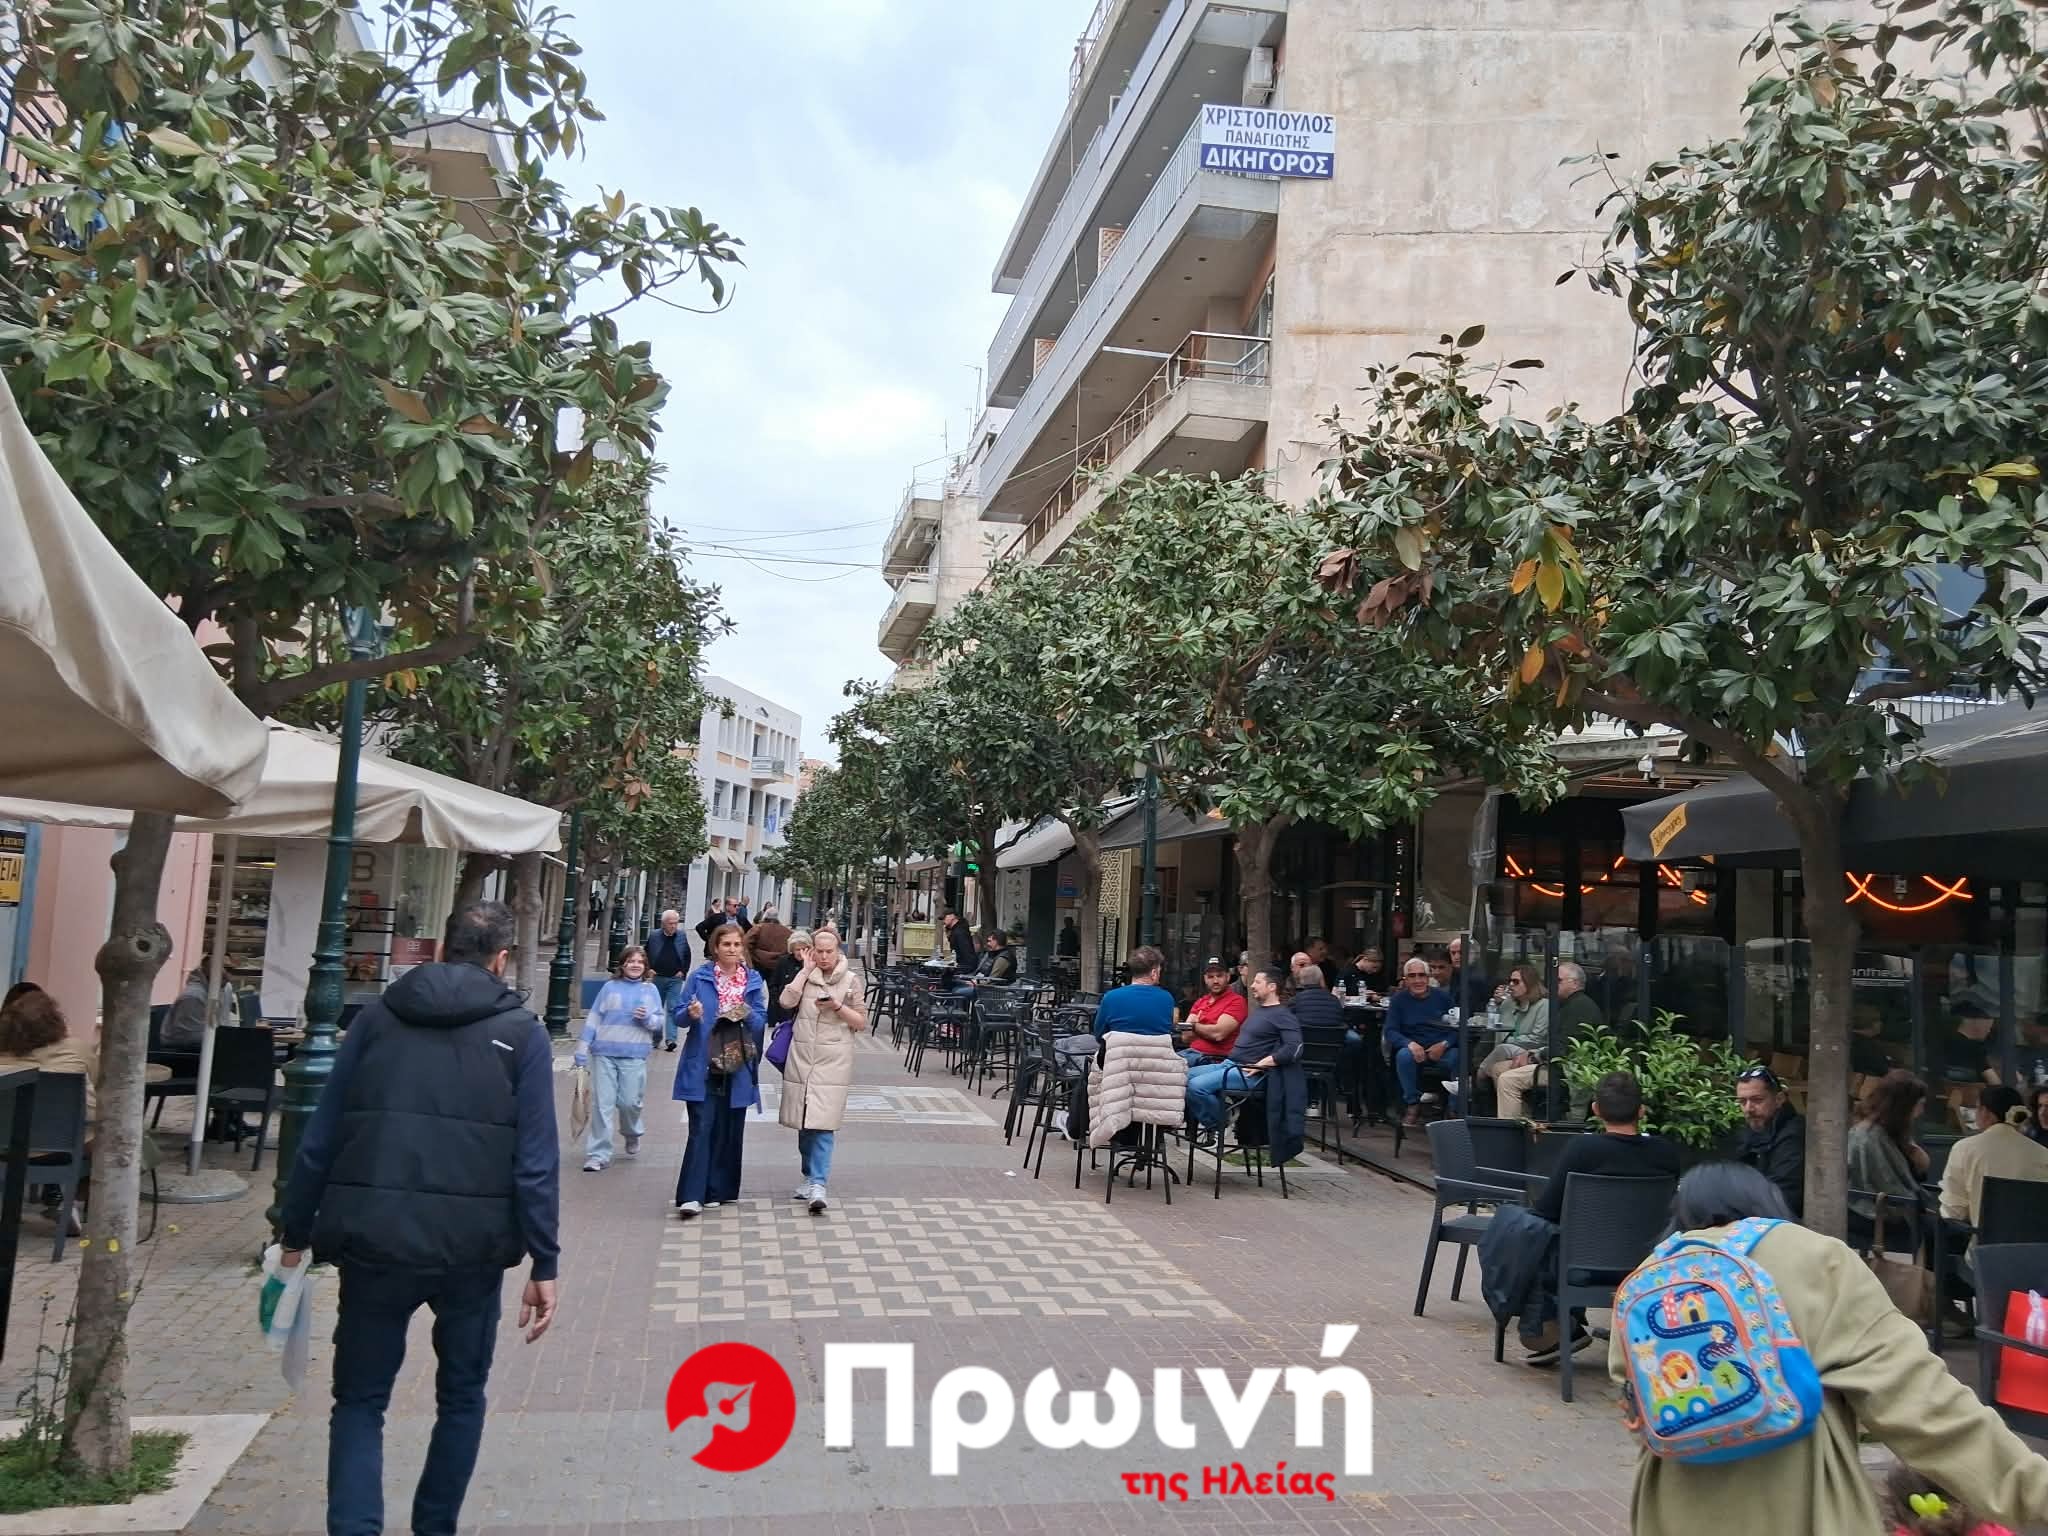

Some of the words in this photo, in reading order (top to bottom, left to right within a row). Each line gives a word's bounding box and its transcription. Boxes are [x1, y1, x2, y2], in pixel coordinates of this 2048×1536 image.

[1205, 107, 1334, 134] ΧΡΙΣΤΟΠΟΥΛΟΣ
[1225, 129, 1310, 149] ΠΑΝΑΓΙΩΤΗΣ
[1205, 147, 1329, 175] ΔΙΚΗΓΟΡΟΣ
